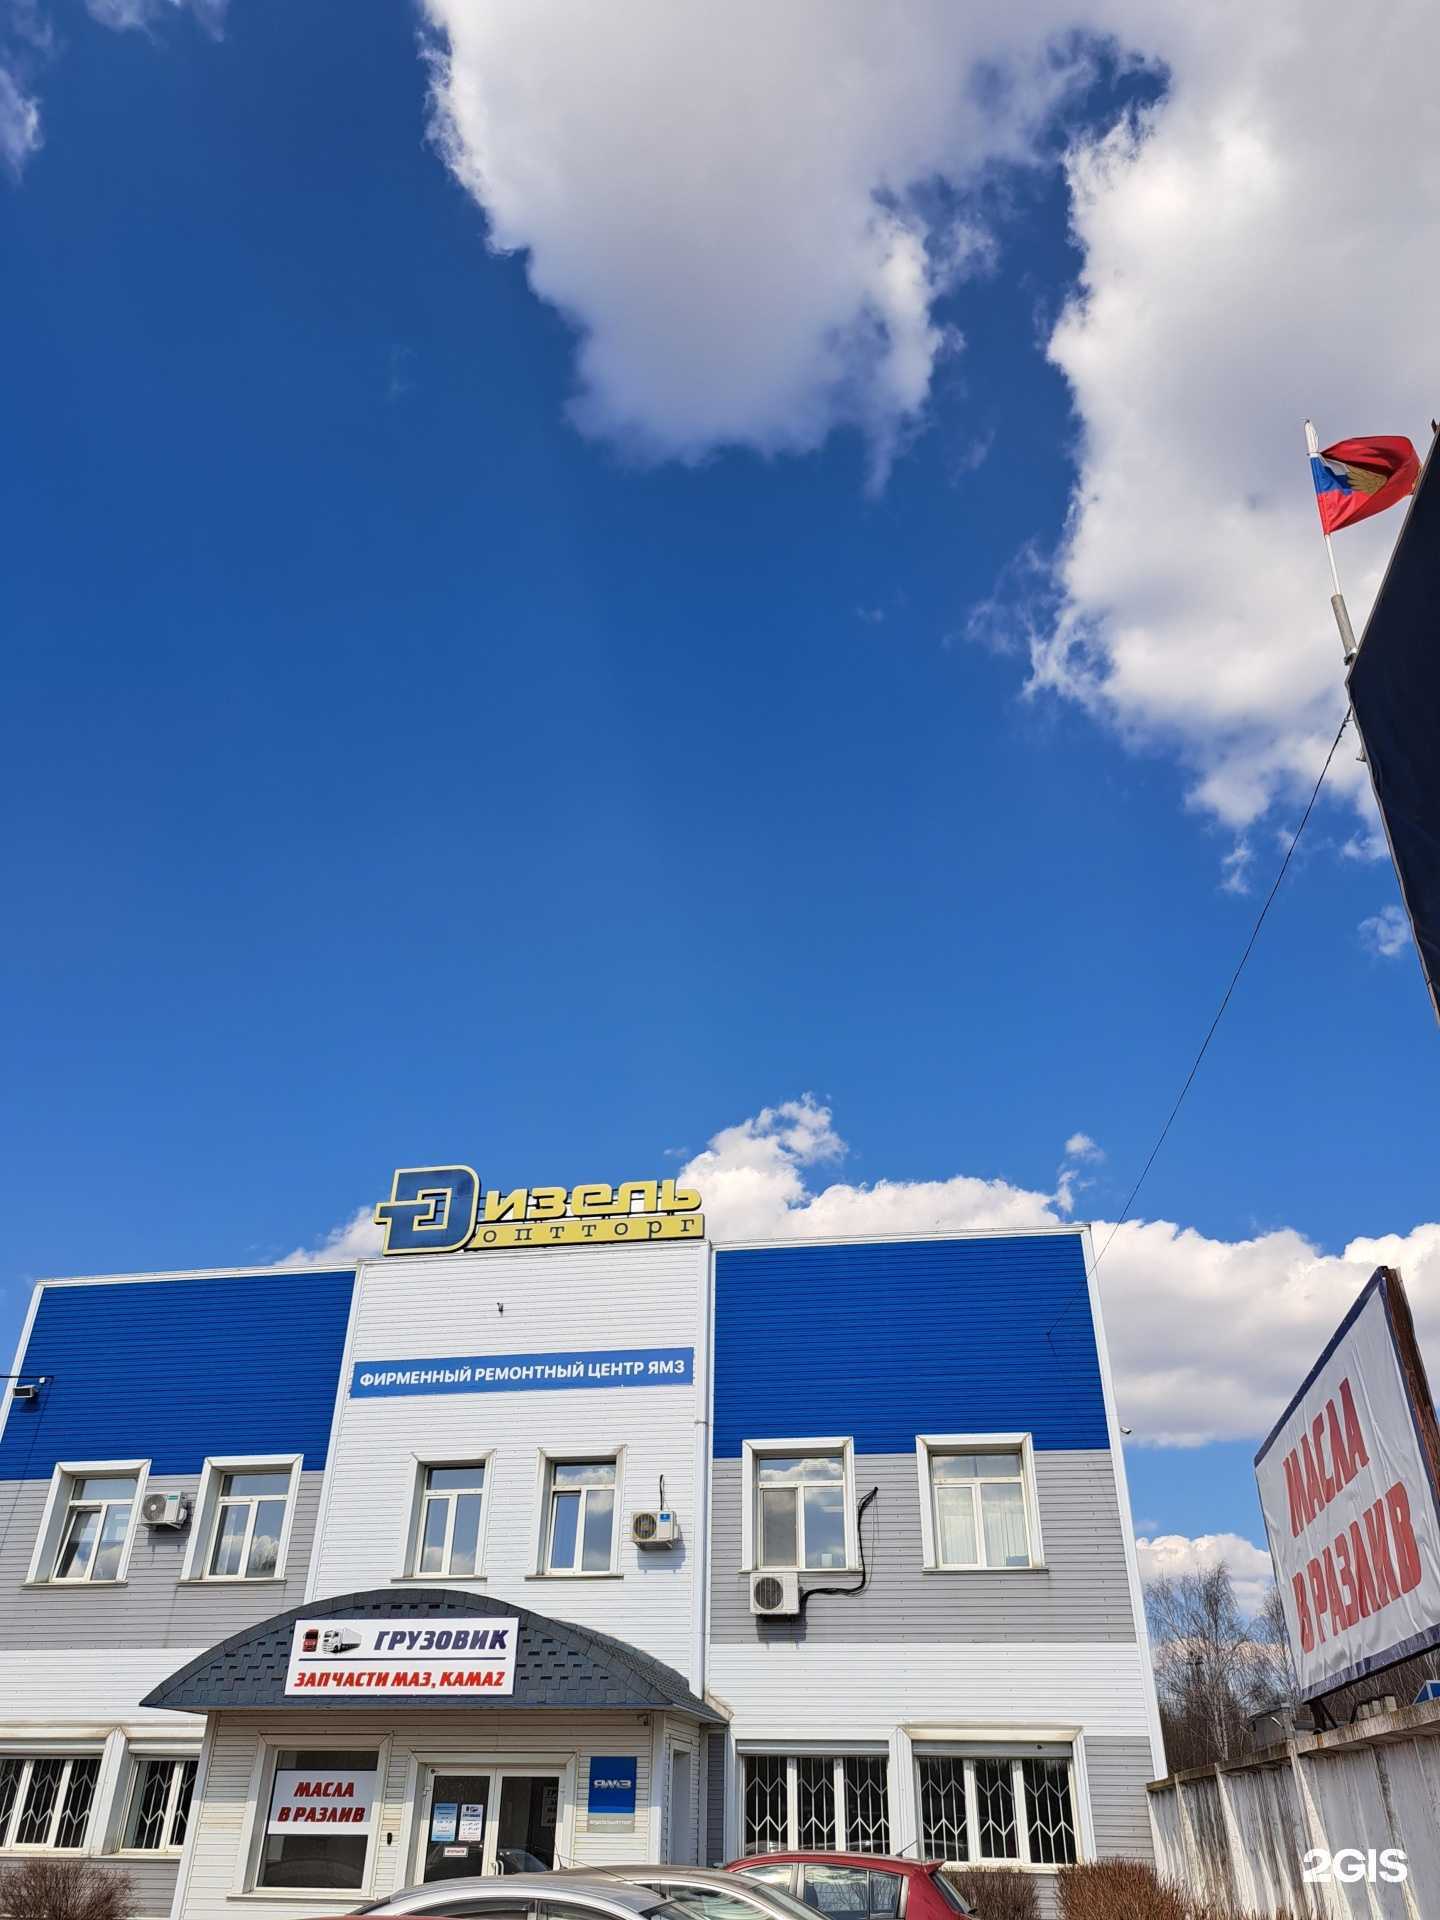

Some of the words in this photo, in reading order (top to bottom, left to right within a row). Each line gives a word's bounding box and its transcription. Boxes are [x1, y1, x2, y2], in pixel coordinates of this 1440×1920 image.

[359, 1364, 472, 1387] ФИРМЕННЫЙ
[475, 1362, 585, 1382] РЕМОНТНЫЙ
[588, 1361, 645, 1379] ЦЕНТР
[648, 1359, 686, 1375] ЯМЗ
[1282, 1377, 1370, 1539] МАСЛА
[1292, 1571, 1314, 1654] В
[1308, 1481, 1423, 1644] РАЗЛИВ
[373, 1629, 509, 1652] ГРУЗОВИК
[293, 1671, 389, 1688] ЗАПЧАСТИ
[391, 1671, 436, 1689] МАЗ,
[293, 1781, 355, 1798] МАСЛА
[277, 1806, 290, 1823] В
[293, 1806, 366, 1825] РАЗЛИВ
